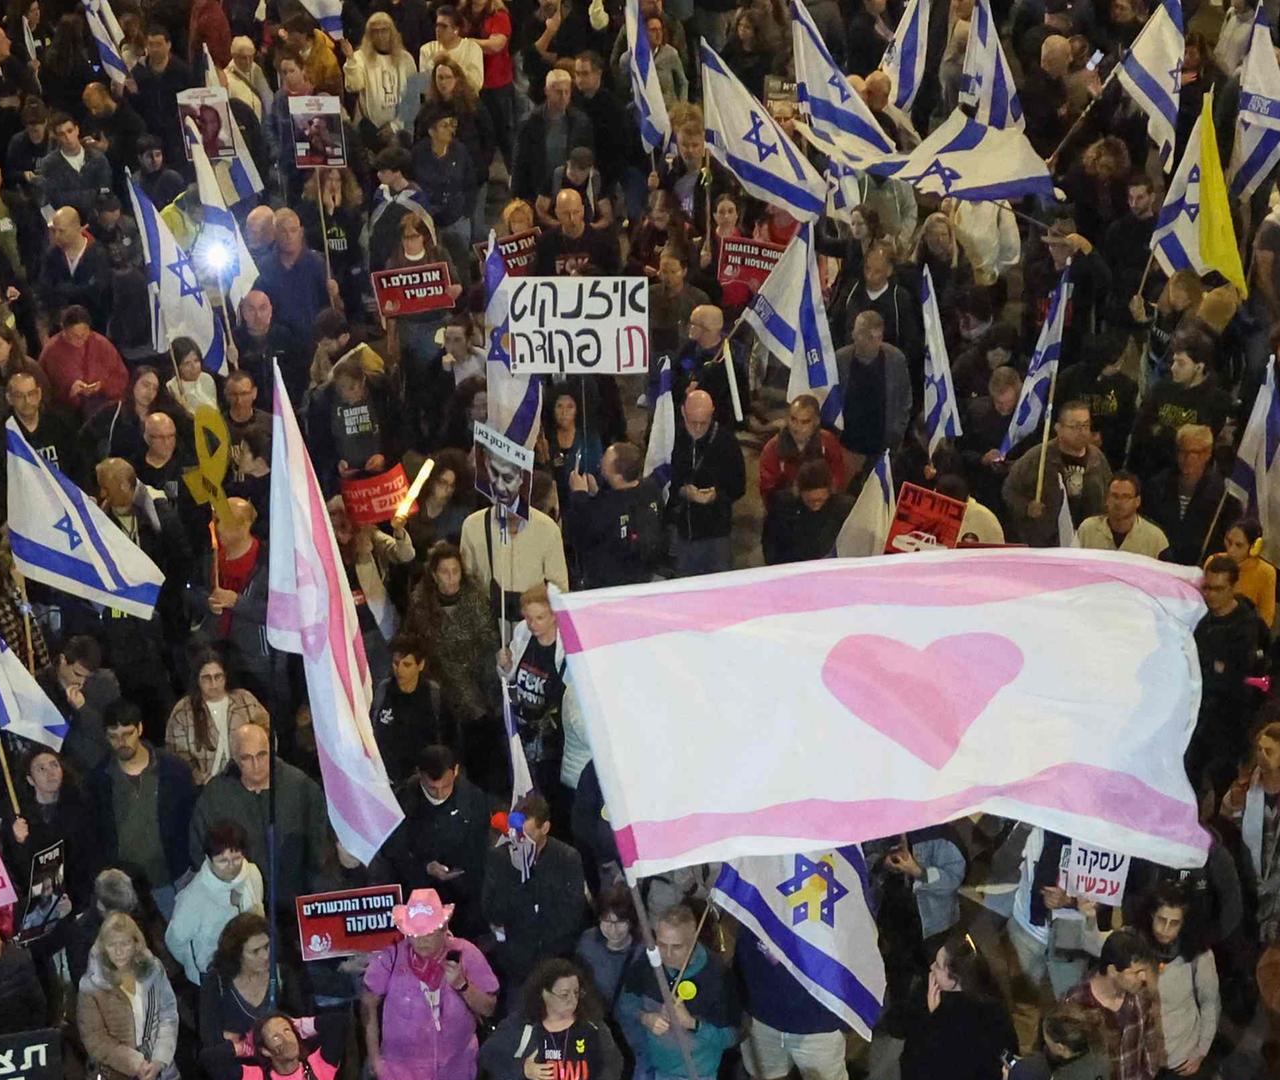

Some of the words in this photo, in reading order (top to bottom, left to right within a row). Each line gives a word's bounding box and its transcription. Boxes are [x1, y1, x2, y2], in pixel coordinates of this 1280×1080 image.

[423, 269, 441, 282] את
[404, 285, 444, 299] עכשיו
[616, 325, 648, 372] תן
[1076, 846, 1125, 875] עסקה
[1076, 874, 1121, 897] עכשיו
[302, 899, 360, 915] המכשולים
[364, 894, 395, 909] הוסרו
